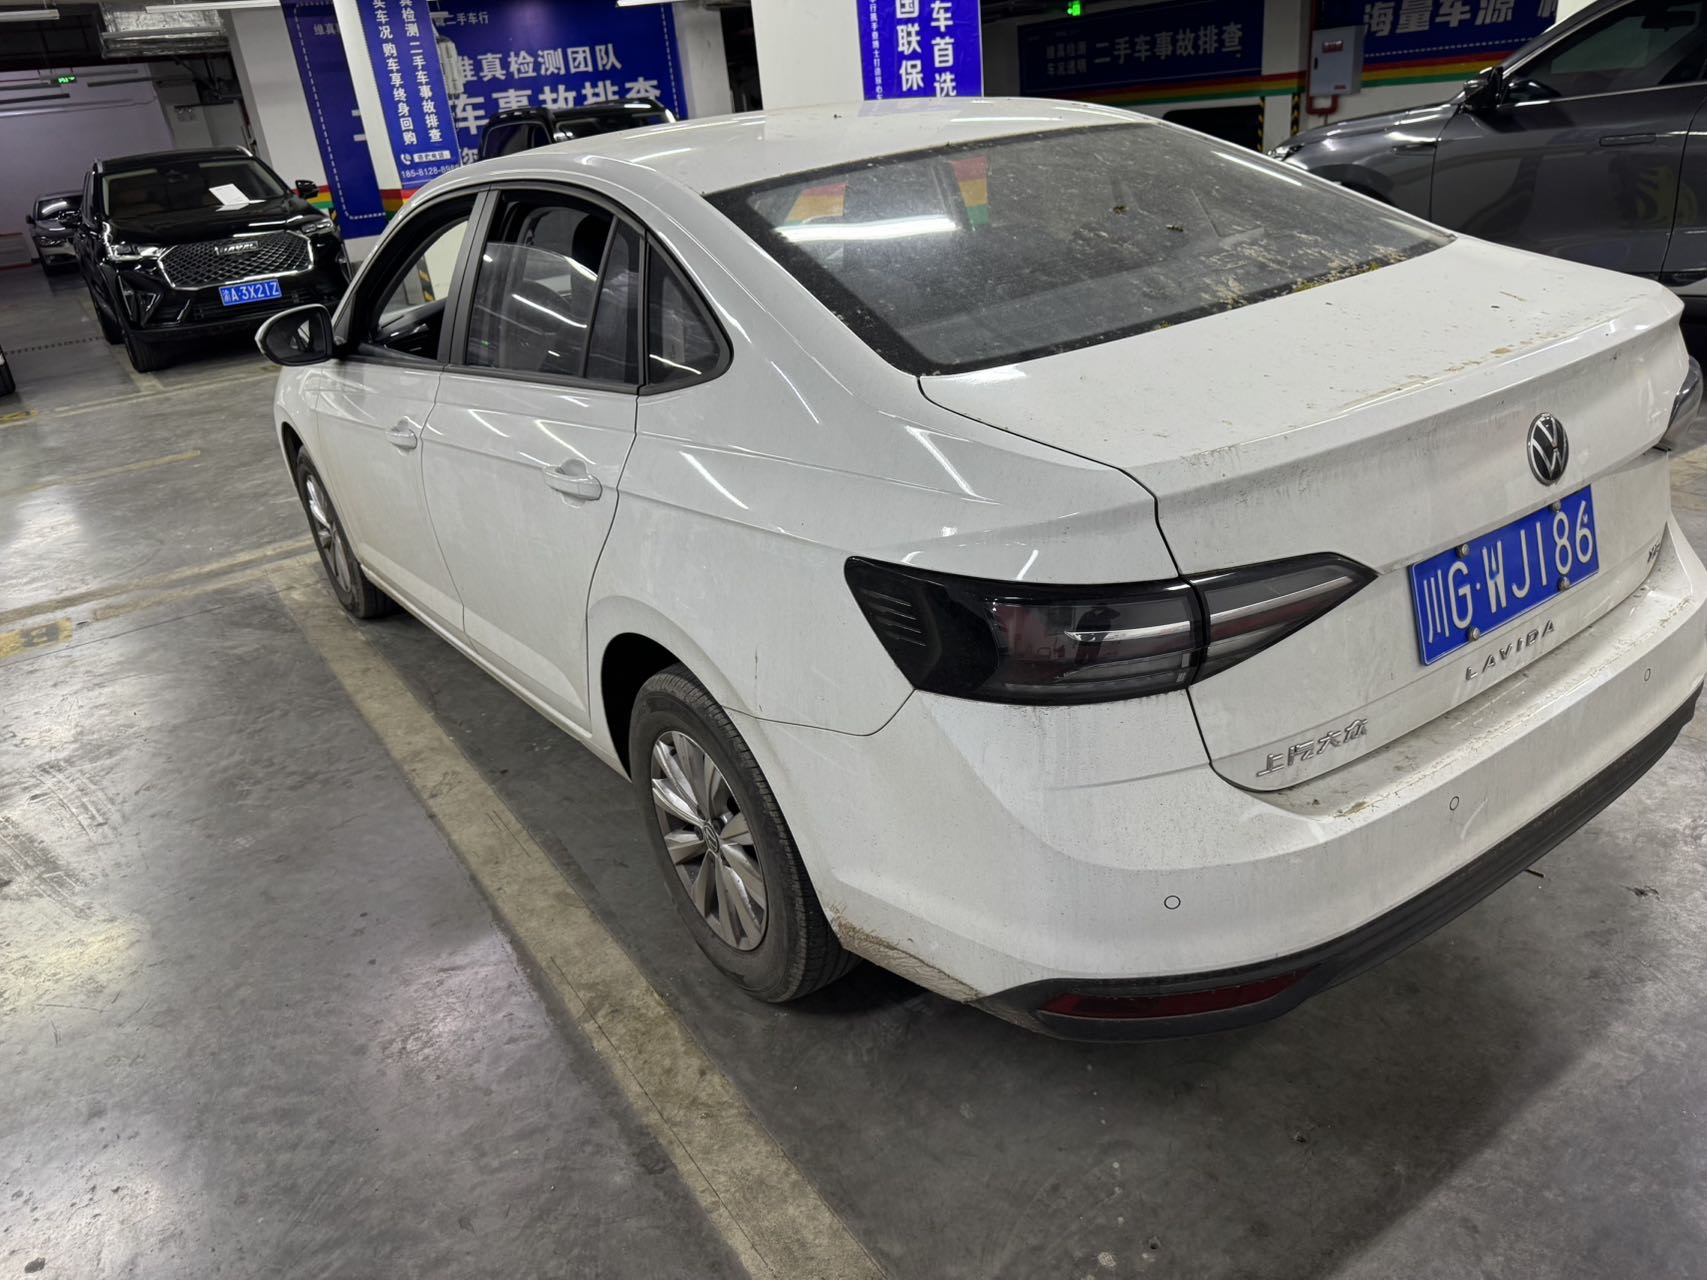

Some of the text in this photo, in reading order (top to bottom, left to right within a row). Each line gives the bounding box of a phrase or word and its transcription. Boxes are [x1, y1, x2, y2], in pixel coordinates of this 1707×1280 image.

[1093, 21, 1243, 65] 二手车事故排查
[1363, 0, 1515, 36] 海量车源
[930, 0, 957, 98] 车首选
[410, 42, 443, 142] 二手车事故排查
[1465, 619, 1556, 681] LAVIDA
[1256, 718, 1368, 778] 上汽大众
